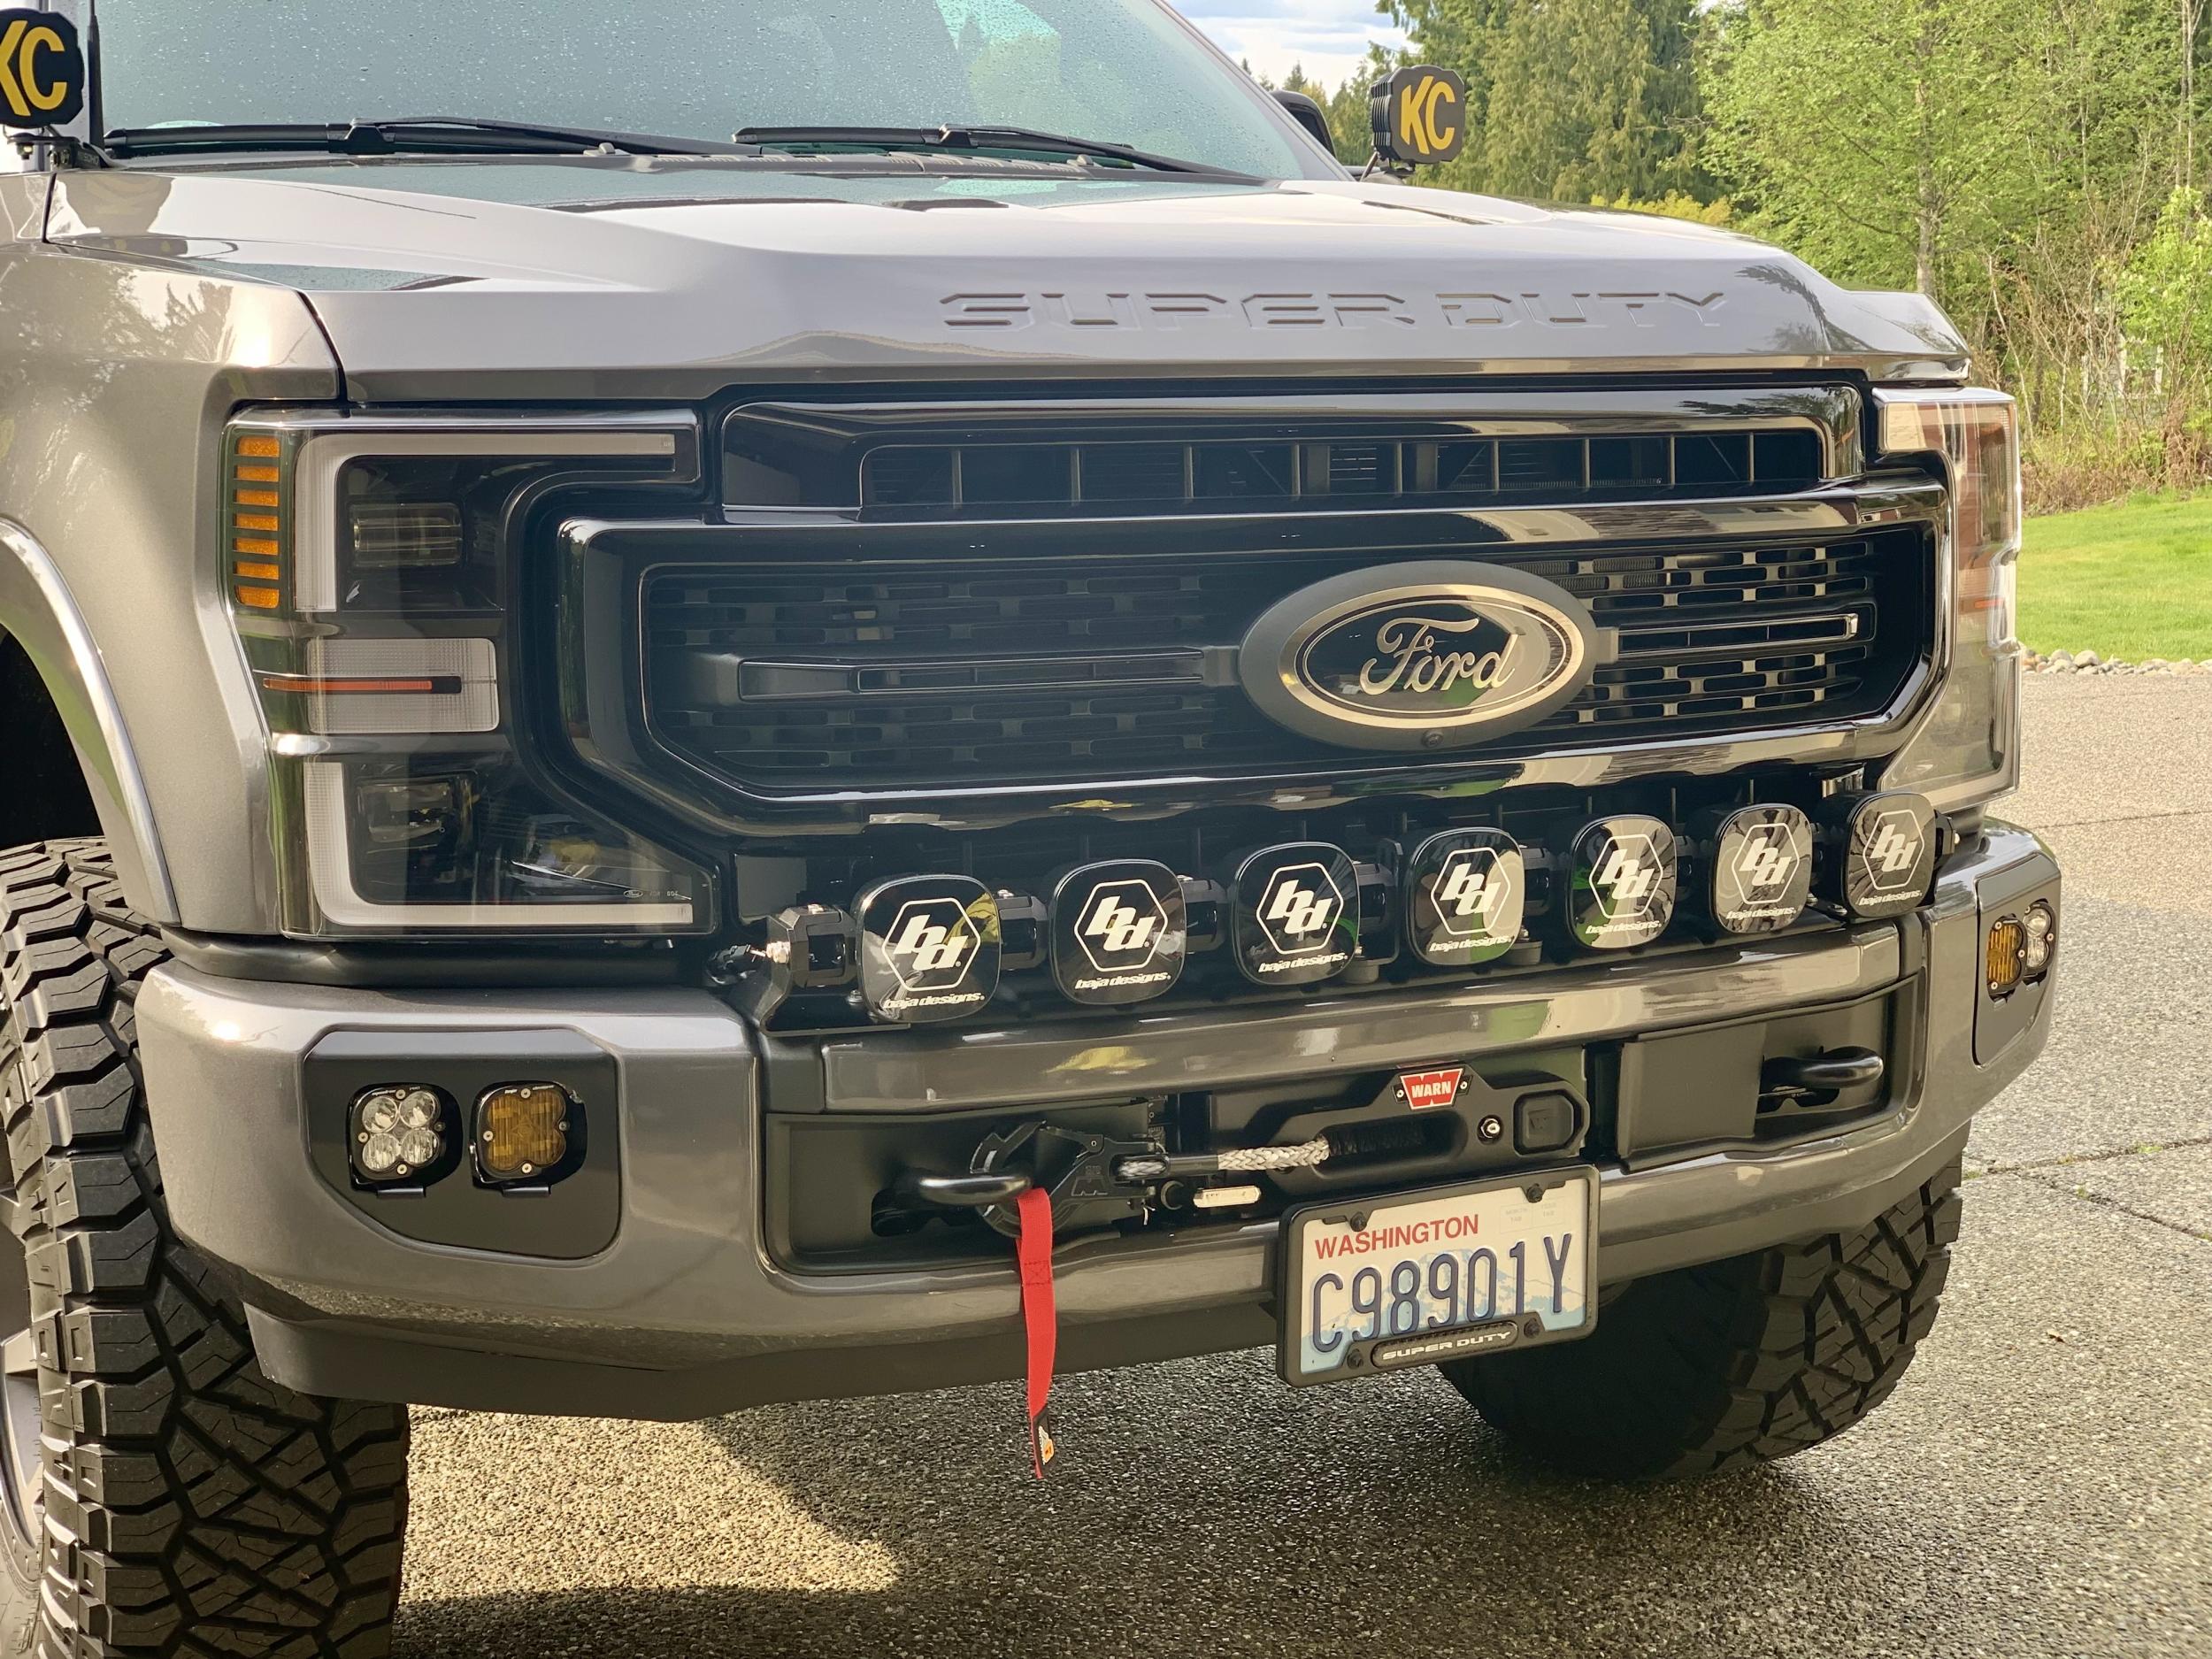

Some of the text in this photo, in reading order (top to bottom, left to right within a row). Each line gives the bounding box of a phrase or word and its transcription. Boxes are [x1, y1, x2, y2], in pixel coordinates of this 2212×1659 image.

[1401, 75, 1455, 154] KC
[940, 293, 1724, 330] SUPER DUTY
[1360, 617, 1518, 695] Ford
[1859, 895, 1883, 906] baja
[1429, 941, 1460, 952] baja
[1258, 960, 1291, 972] baja
[1074, 977, 1110, 990] baja
[883, 998, 919, 1010] baja
[1411, 1080, 1452, 1099] WARN
[1314, 1214, 1480, 1260] WASHINGTON
[1312, 1233, 1572, 1353] C98901Y
[1382, 1331, 1511, 1360] SUPER DUTY
